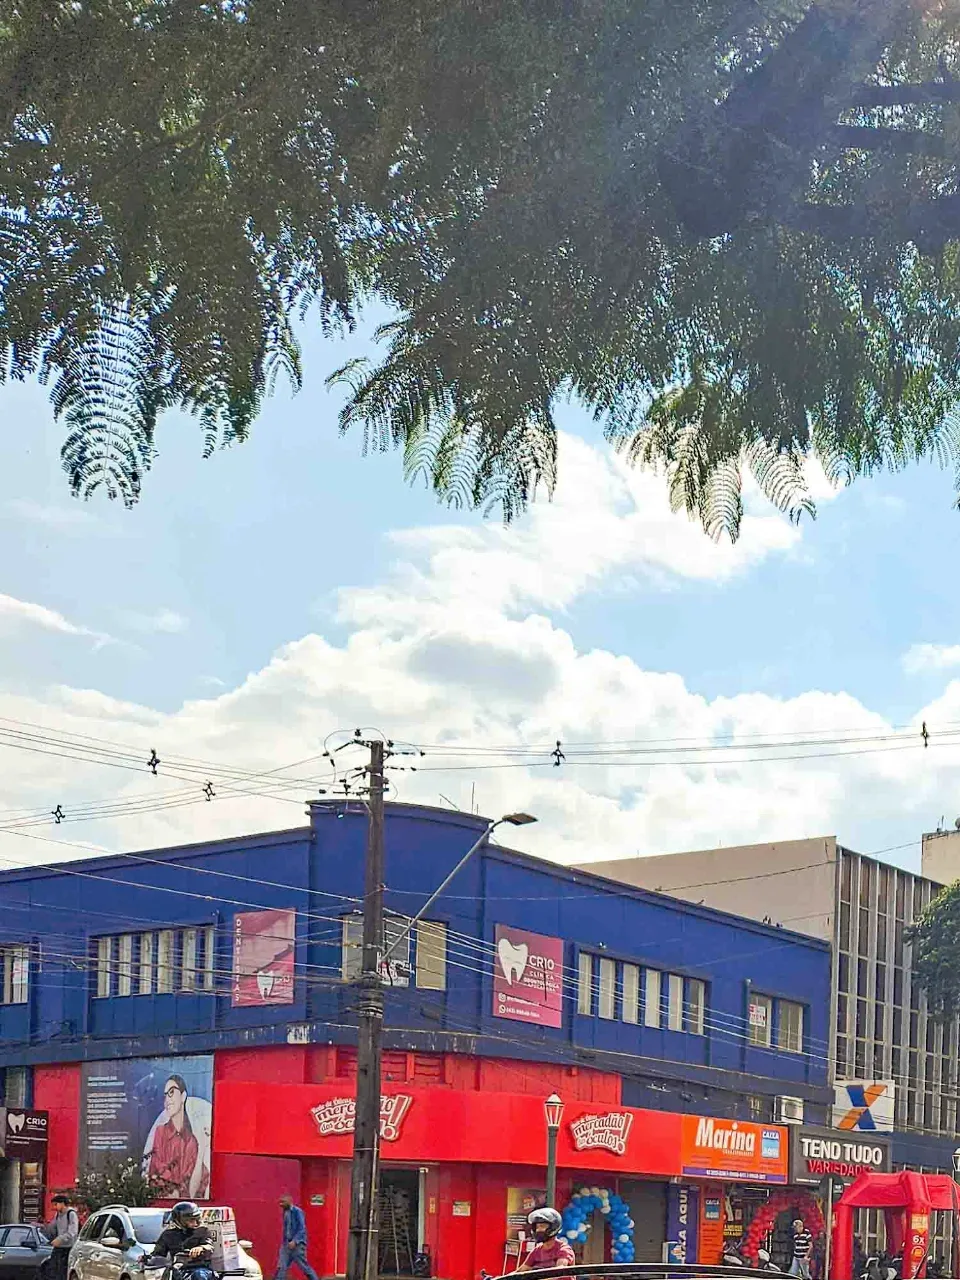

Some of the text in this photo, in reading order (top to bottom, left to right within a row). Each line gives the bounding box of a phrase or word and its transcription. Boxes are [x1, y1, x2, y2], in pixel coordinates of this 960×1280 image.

[695, 1118, 756, 1151] Marina
[801, 1138, 883, 1165] TEND TUDO
[808, 1160, 876, 1177] VARIEDAD
